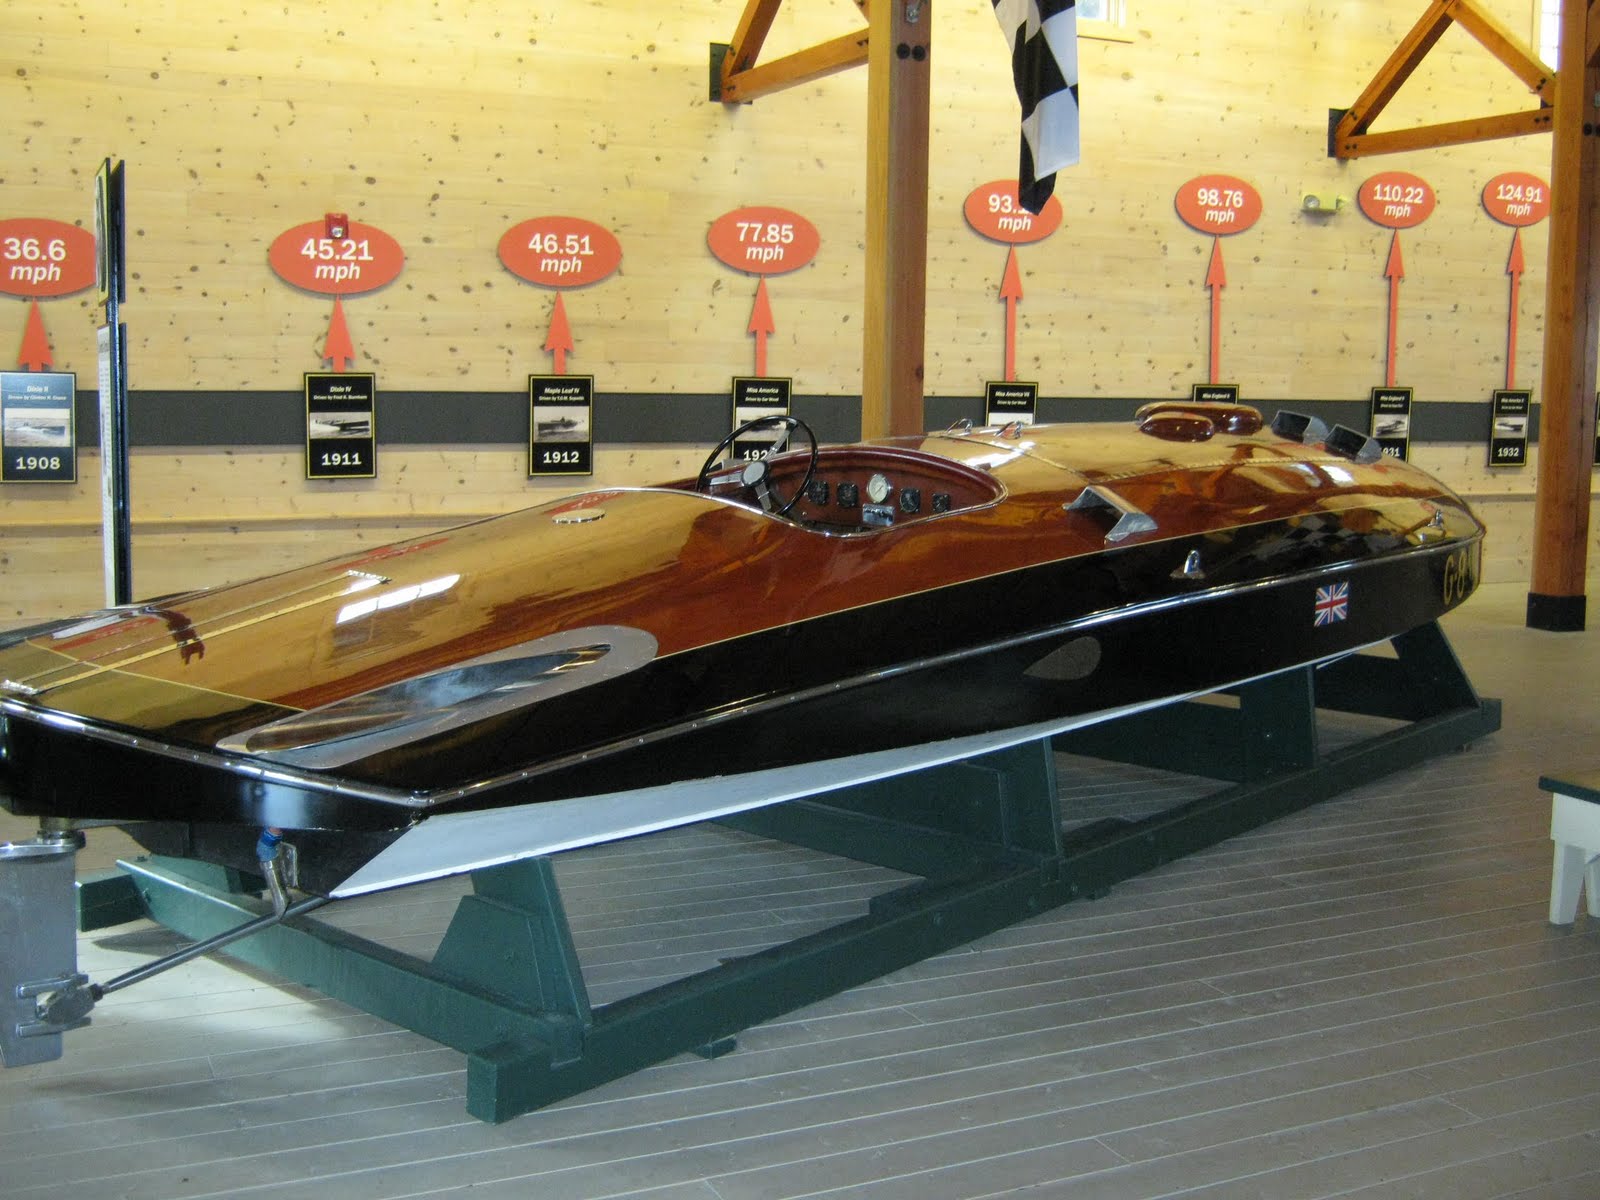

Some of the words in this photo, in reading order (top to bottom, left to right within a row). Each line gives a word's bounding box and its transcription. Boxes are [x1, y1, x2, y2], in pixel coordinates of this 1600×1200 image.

[1197, 188, 1243, 208] 98.76
[1373, 184, 1424, 204] 110.22
[1496, 184, 1543, 204] 124.91
[1205, 208, 1236, 225] mph
[1384, 204, 1411, 219] mph
[1506, 202, 1531, 218] mph
[736, 222, 794, 244] 77.85
[998, 215, 1032, 233] mph
[4, 237, 67, 261] 36.6
[301, 238, 374, 261] 45.21
[528, 233, 594, 255] 46.51
[746, 244, 784, 264] mph
[10, 263, 61, 285] mph
[315, 261, 361, 283] mph
[540, 256, 582, 276] mph
[544, 387, 561, 395] Maple
[321, 453, 362, 466] 1911
[543, 451, 580, 464] 1912
[743, 449, 768, 461] 192
[1381, 447, 1401, 458] 931
[1497, 447, 1520, 458] 1932
[16, 456, 61, 470] 1908
